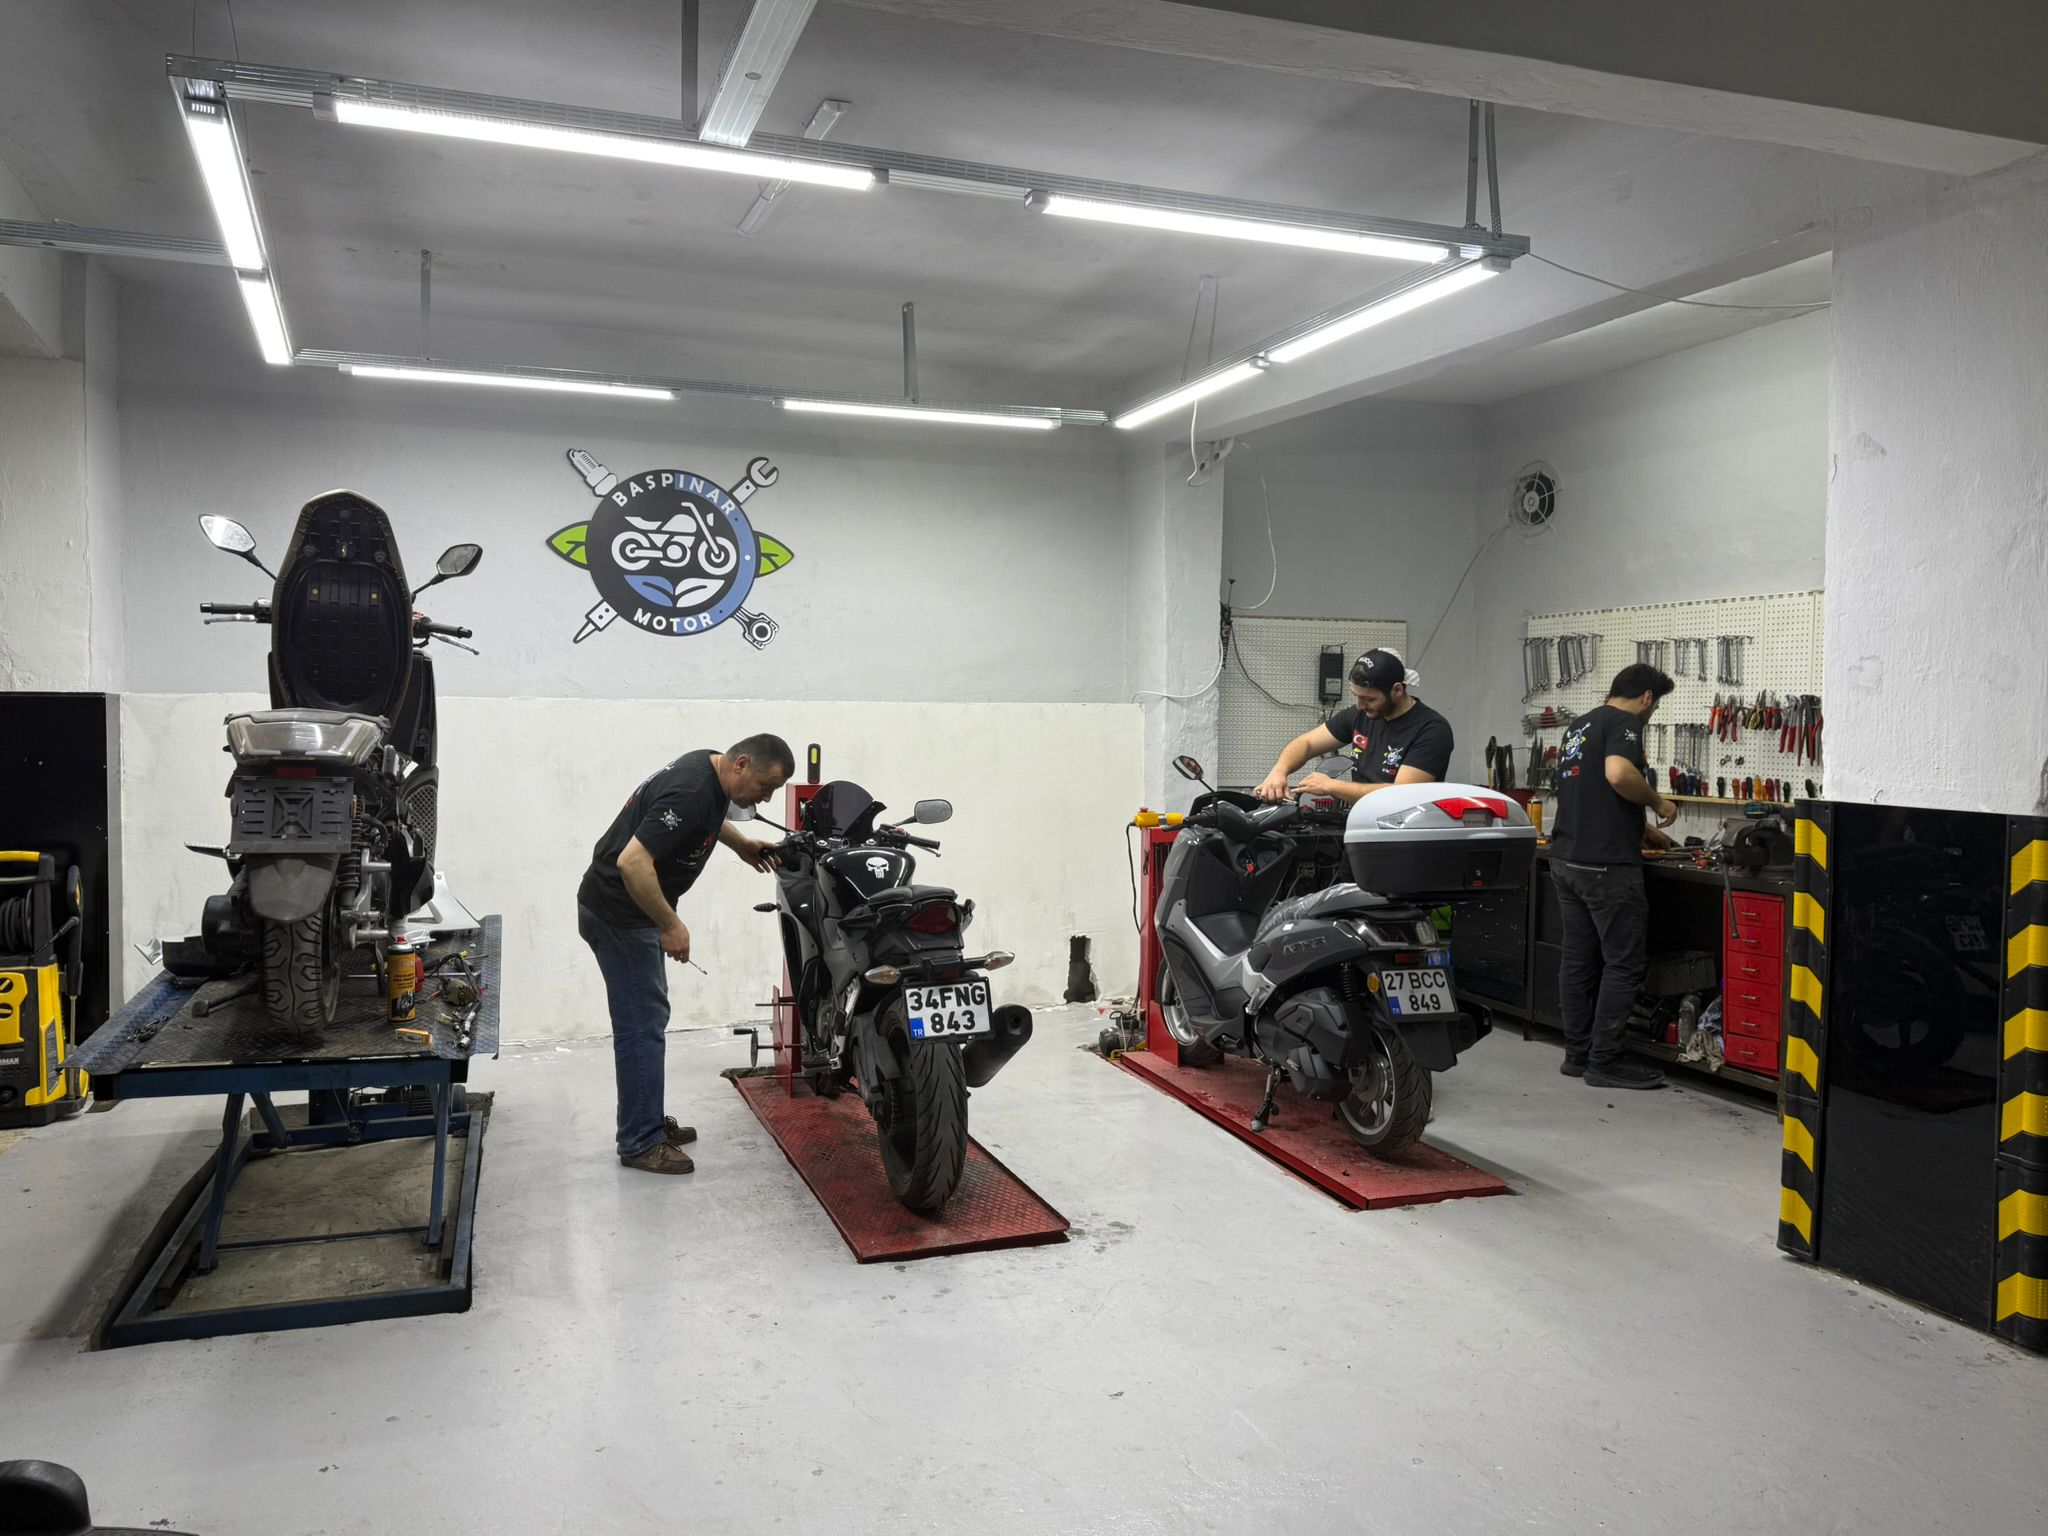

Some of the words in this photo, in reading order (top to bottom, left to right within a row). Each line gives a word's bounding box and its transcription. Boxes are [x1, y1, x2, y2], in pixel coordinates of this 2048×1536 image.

[633, 608, 713, 632] MOTOR
[1385, 973, 1404, 990] 27
[1408, 972, 1445, 989] BCC
[1409, 993, 1441, 1012] 849
[930, 1010, 975, 1033] 843
[913, 1028, 924, 1037] TR
